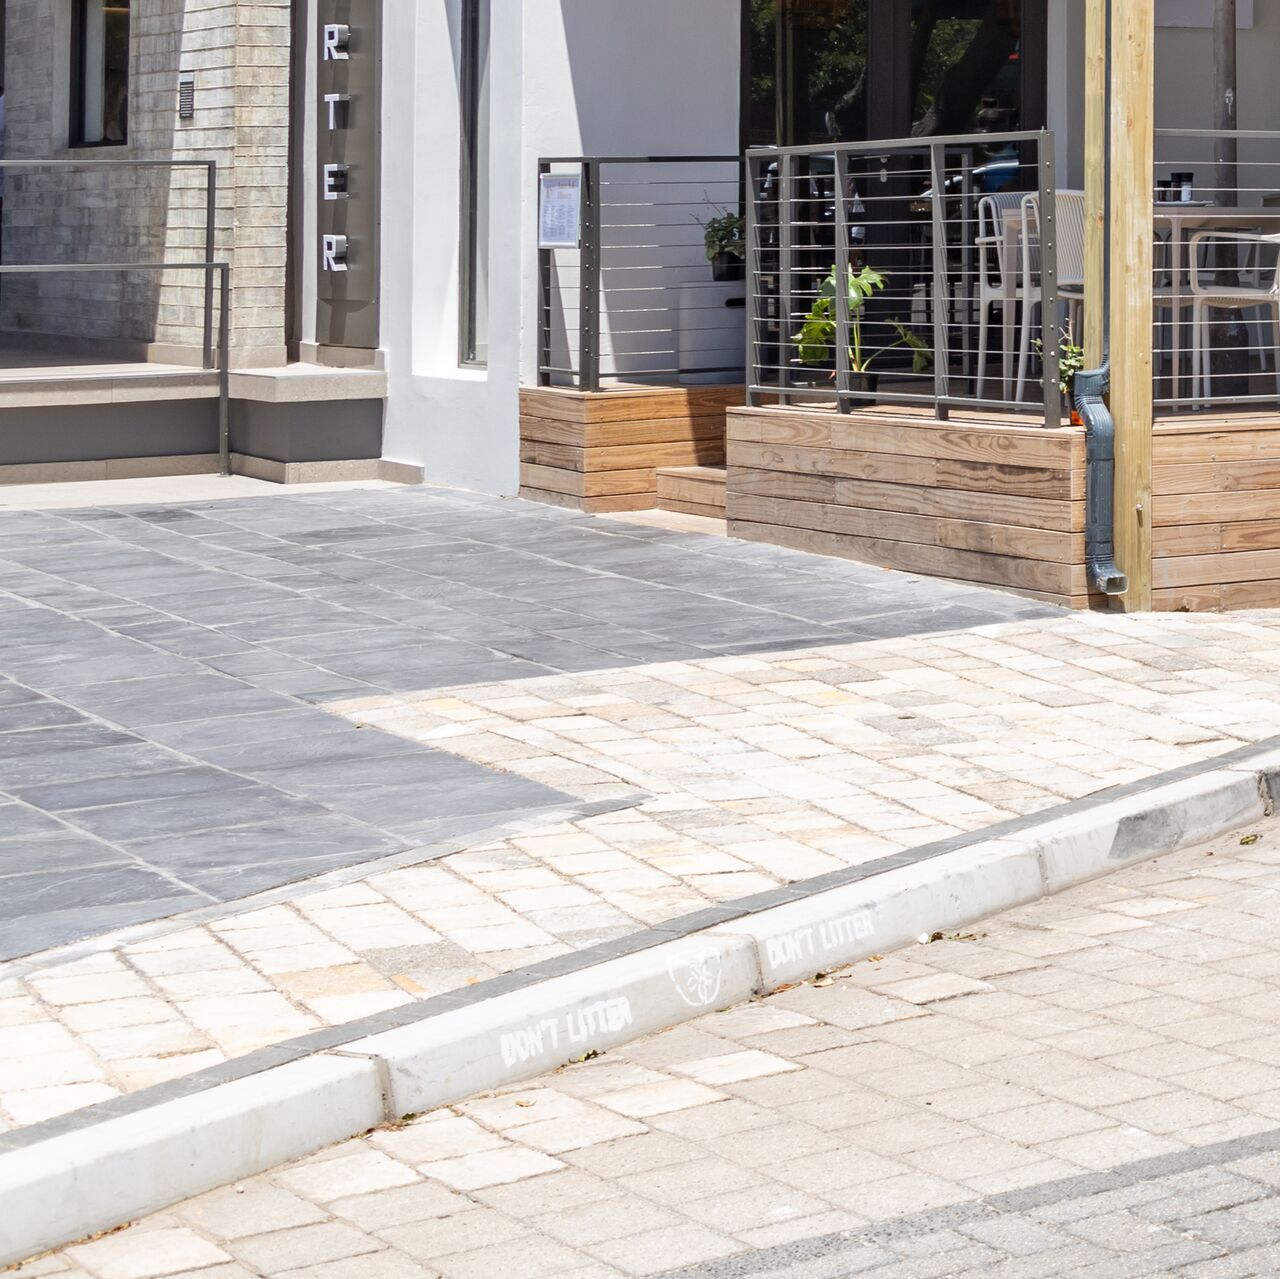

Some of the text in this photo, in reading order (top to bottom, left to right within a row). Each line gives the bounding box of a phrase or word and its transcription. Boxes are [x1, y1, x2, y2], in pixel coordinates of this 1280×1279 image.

[764, 907, 876, 969] DON'T LITTER
[500, 996, 634, 1069] DON'T LITTER
